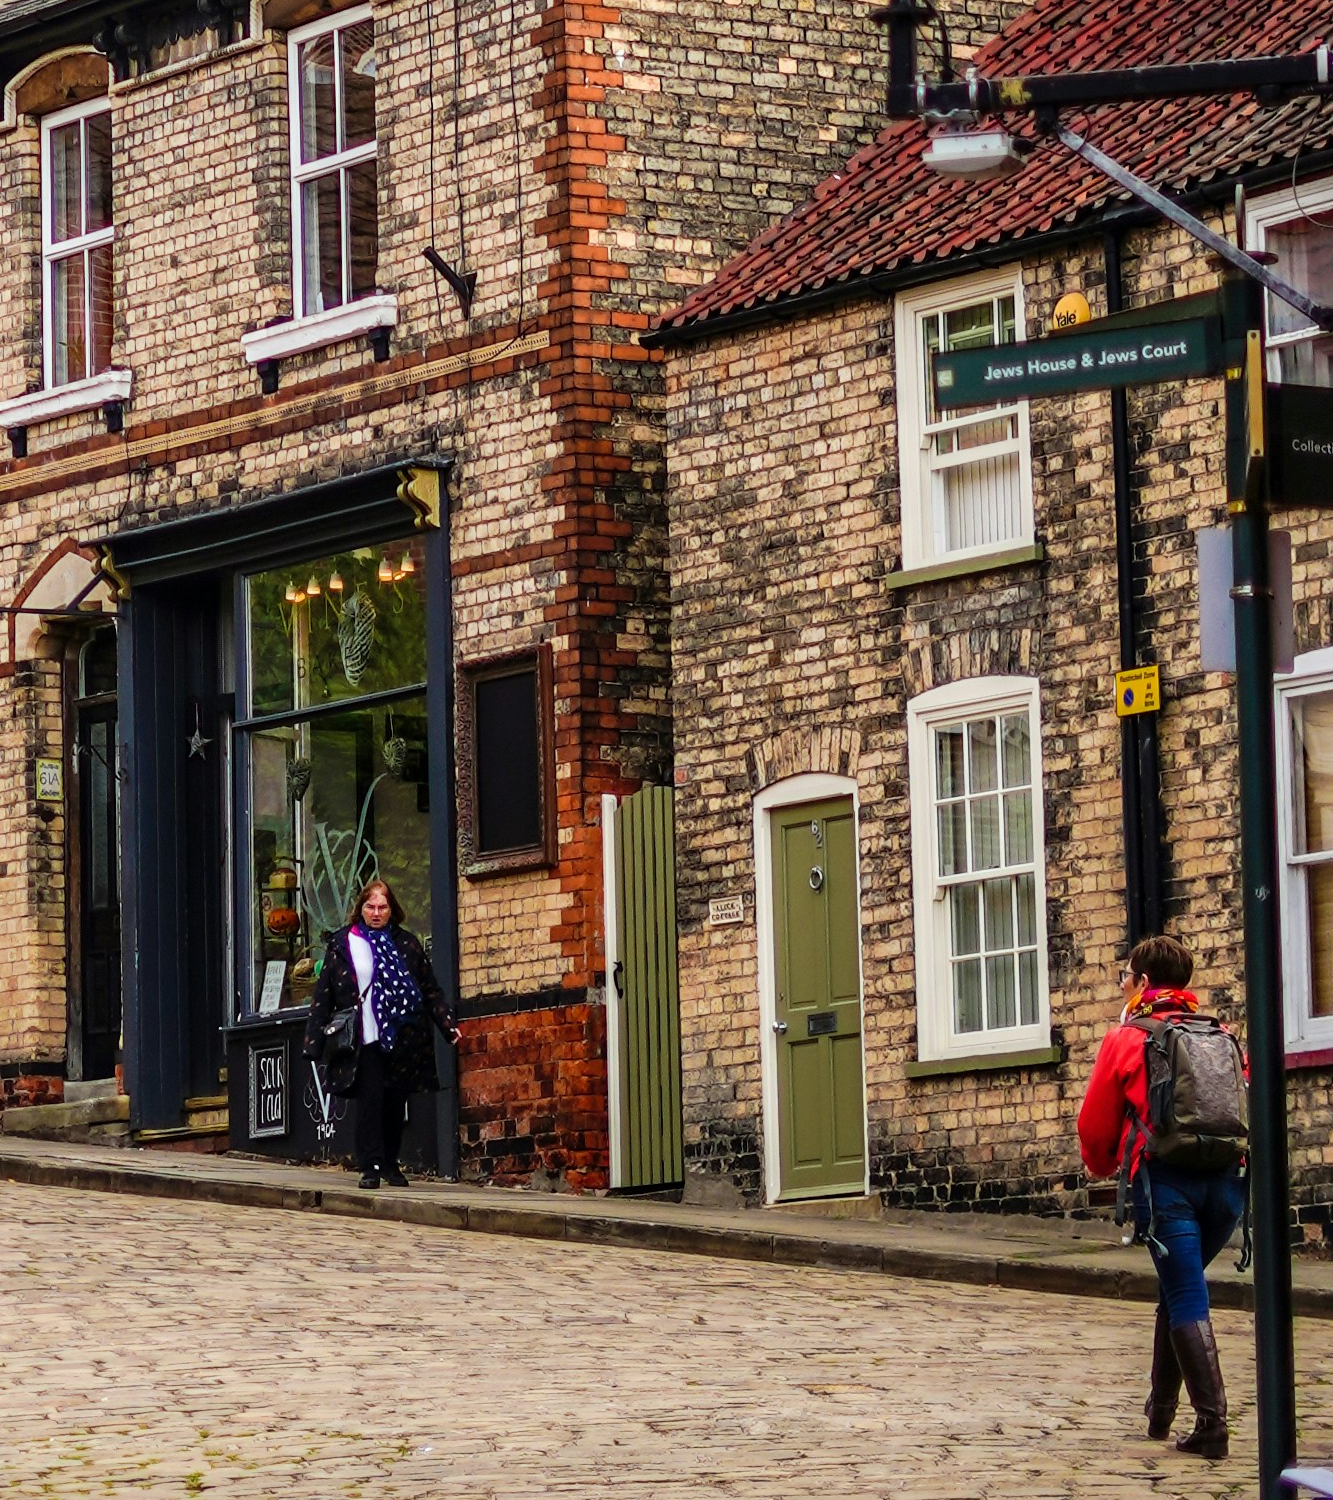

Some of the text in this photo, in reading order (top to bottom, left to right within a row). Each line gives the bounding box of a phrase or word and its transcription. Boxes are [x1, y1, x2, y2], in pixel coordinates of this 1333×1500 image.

[1055, 312, 1077, 327] Yale
[984, 341, 1187, 381] Jews House & Jews Court
[811, 819, 823, 848] 62
[316, 1122, 336, 1141] 1904
